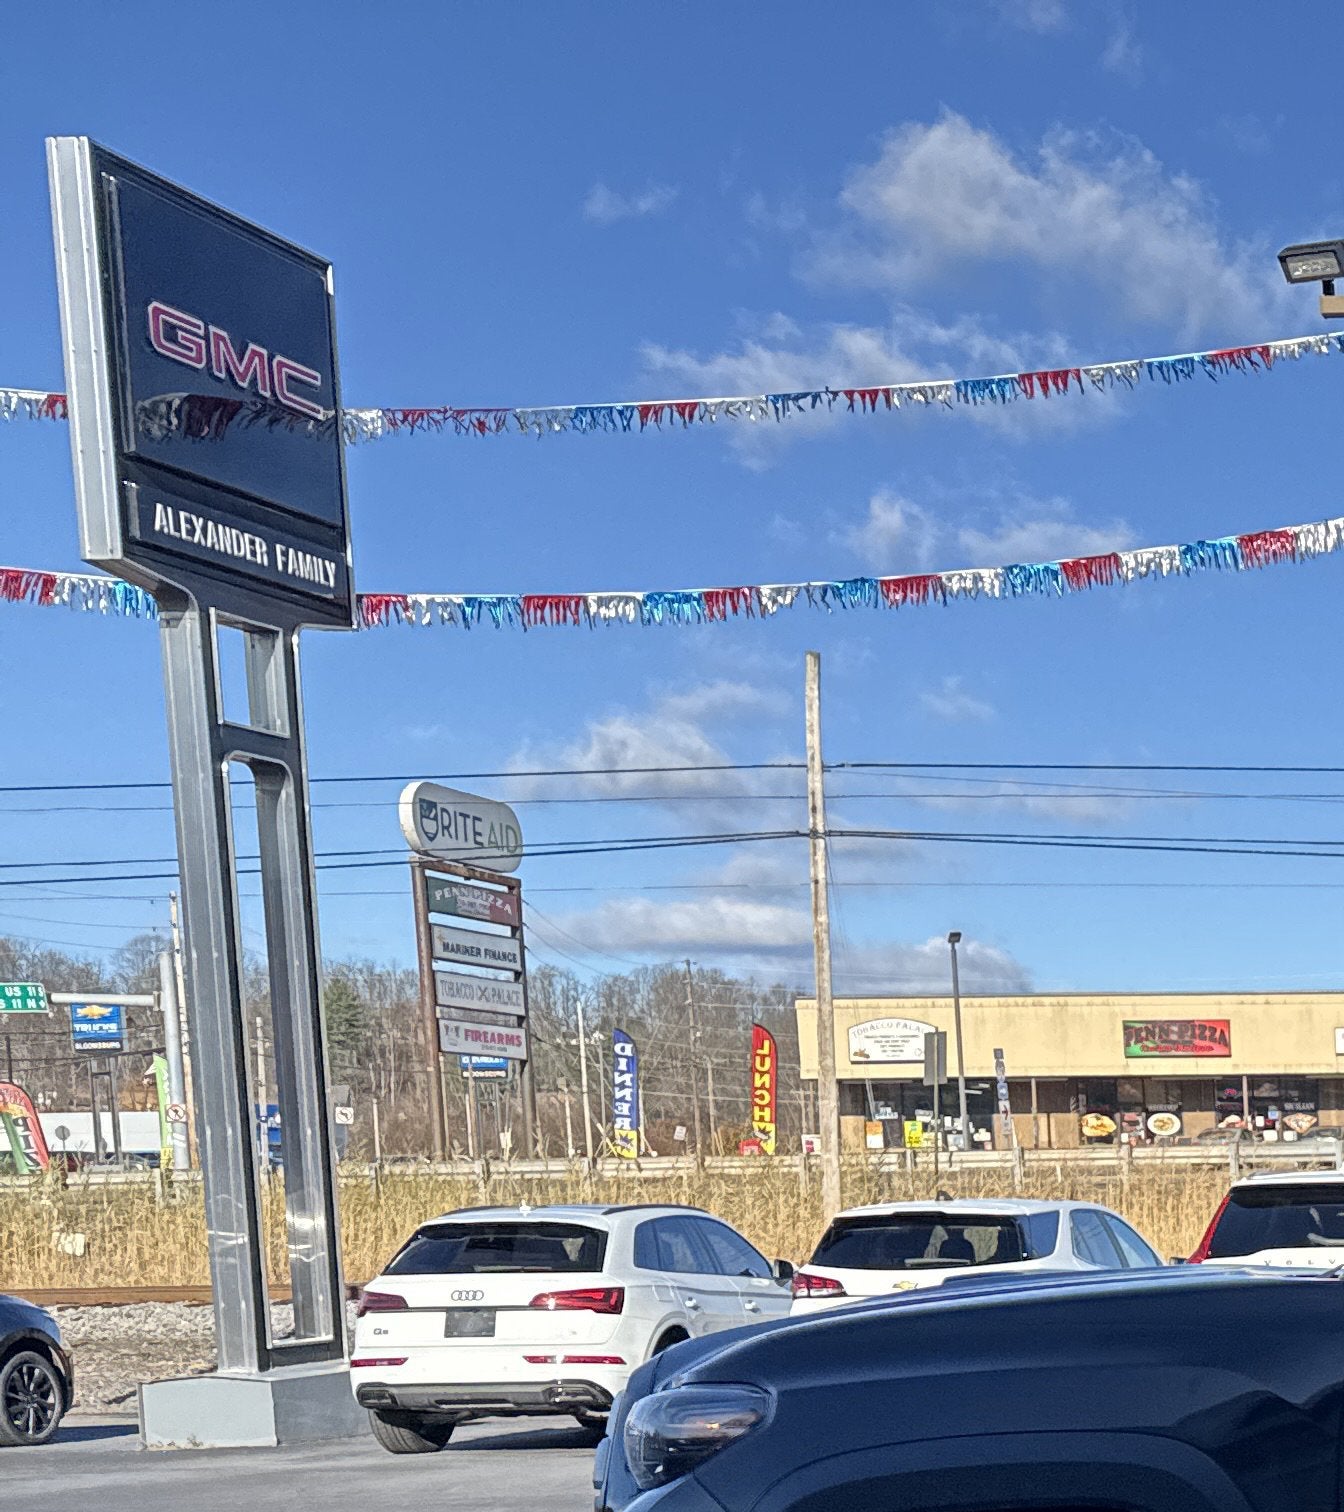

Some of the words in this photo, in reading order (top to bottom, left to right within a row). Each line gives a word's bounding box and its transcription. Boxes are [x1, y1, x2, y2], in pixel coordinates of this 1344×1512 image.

[148, 301, 324, 420] GMC
[154, 503, 269, 567] ALEXANDER
[275, 543, 336, 588] FAMILY
[440, 806, 485, 849] RITE
[487, 821, 519, 854] AID
[435, 886, 469, 901] PENN
[473, 887, 513, 916] PIZZA
[442, 941, 481, 959] MARINER
[484, 948, 518, 964] FINANCE
[4, 986, 22, 997] US
[26, 986, 37, 997] 11
[12, 998, 22, 1009] 11
[26, 998, 37, 1009] N
[464, 1028, 523, 1048] FIREARMS
[895, 1022, 926, 1034] PALAC
[1178, 1022, 1229, 1048] PIZZA
